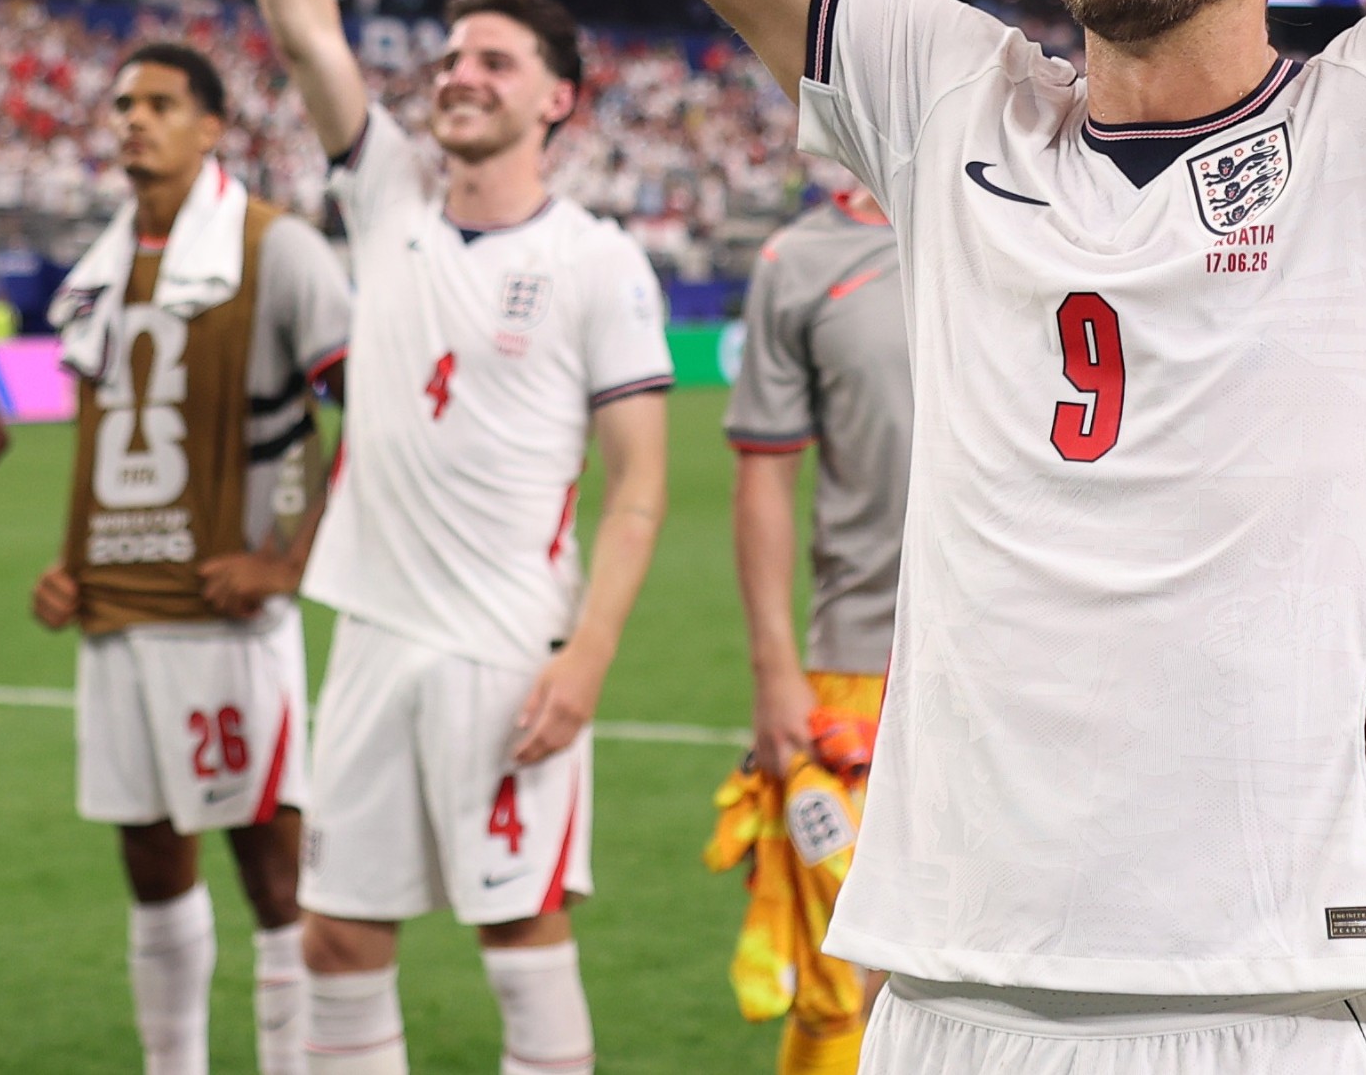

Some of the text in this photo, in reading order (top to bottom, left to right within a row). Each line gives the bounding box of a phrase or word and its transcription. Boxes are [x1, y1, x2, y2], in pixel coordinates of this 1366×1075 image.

[1205, 252, 1268, 273] 17.06.26
[425, 351, 454, 421] 4
[1050, 291, 1126, 463] 9
[85, 530, 196, 565] 2026
[188, 706, 248, 777] 26
[488, 773, 524, 855] 4
